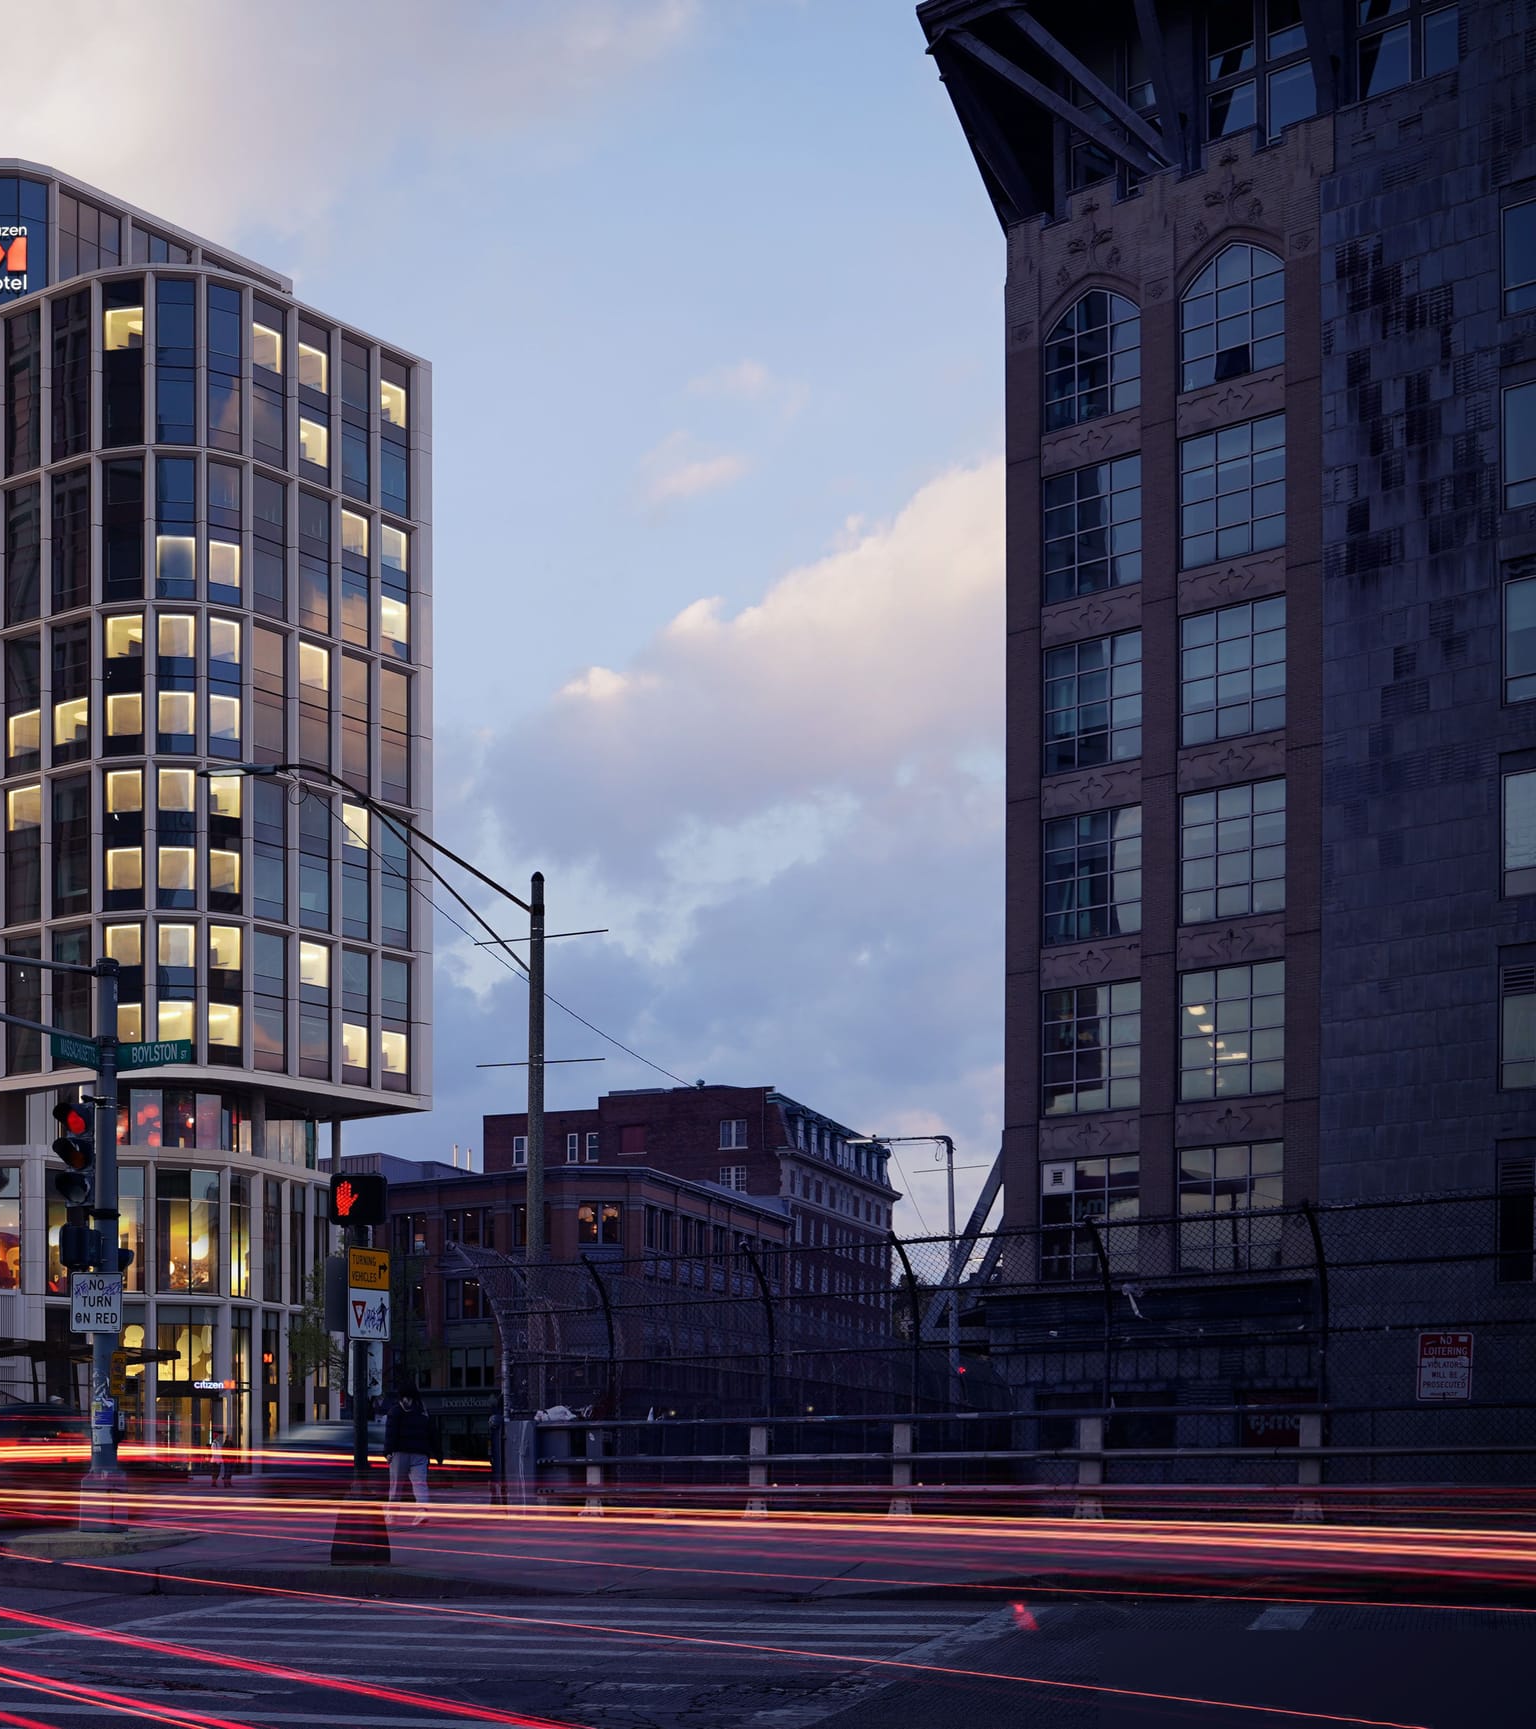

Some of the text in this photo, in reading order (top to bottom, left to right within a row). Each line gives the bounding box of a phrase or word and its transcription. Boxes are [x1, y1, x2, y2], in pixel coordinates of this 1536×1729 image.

[132, 1043, 187, 1063] BOYLSTON ST
[352, 1254, 376, 1267] TURNING
[352, 1270, 376, 1283] VEHICLES
[89, 1279, 105, 1291] NO
[82, 1295, 112, 1307] TURN
[75, 1312, 118, 1324] ON RED
[1440, 1335, 1453, 1345] NO
[1423, 1346, 1468, 1356] LOITERING
[1423, 1380, 1466, 1388] PROSECUTED
[441, 1397, 490, 1408] Room&Boar
